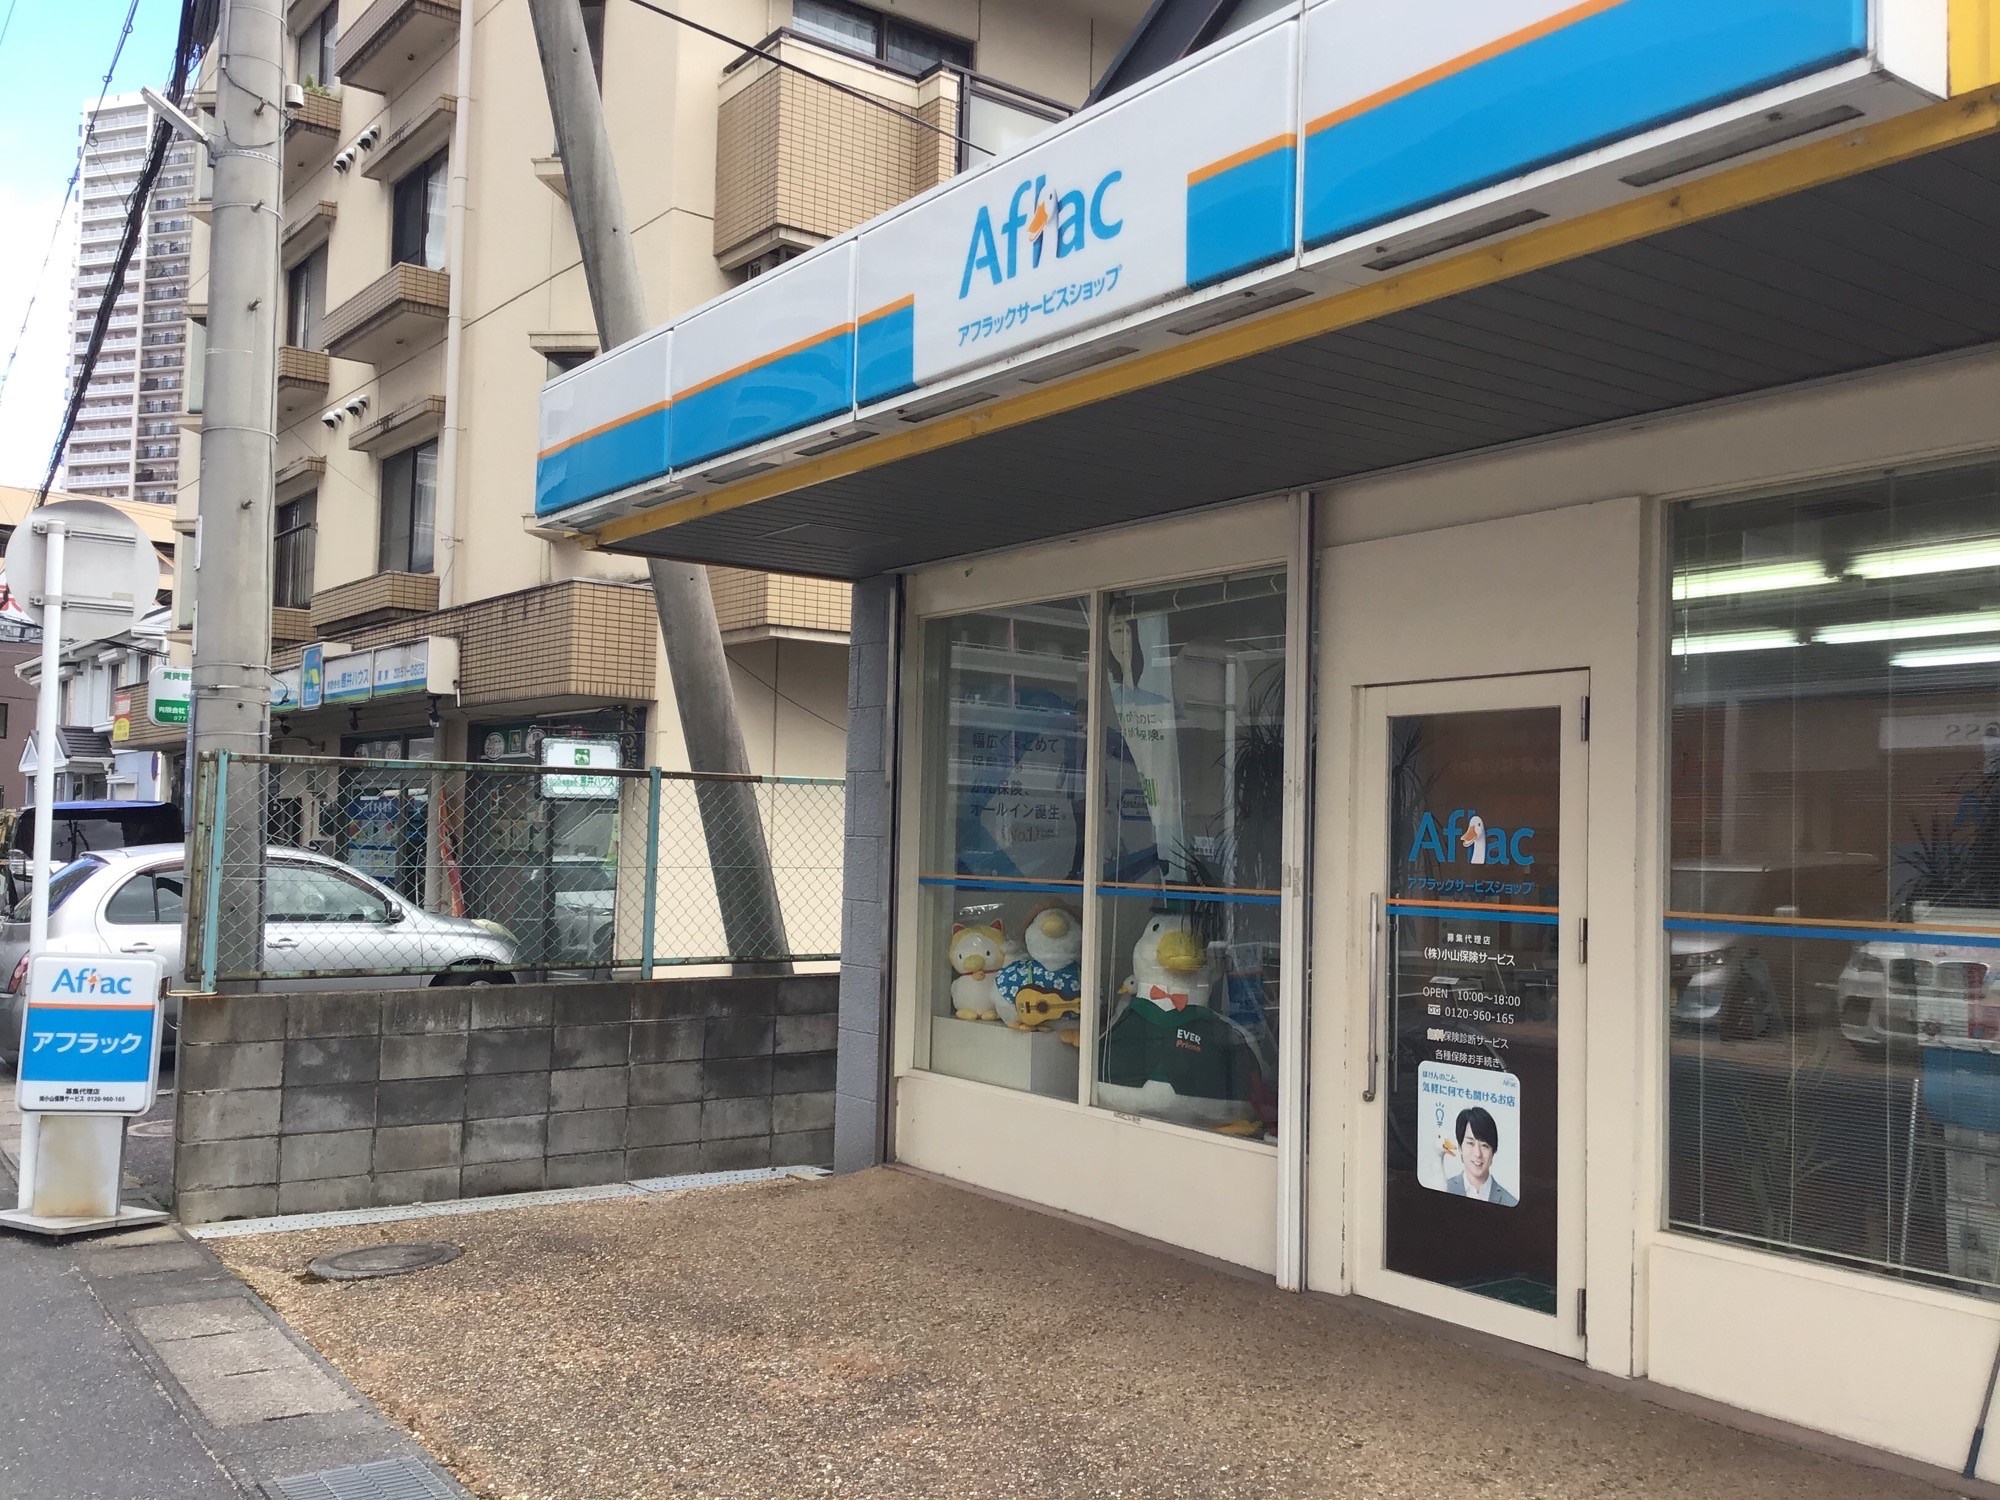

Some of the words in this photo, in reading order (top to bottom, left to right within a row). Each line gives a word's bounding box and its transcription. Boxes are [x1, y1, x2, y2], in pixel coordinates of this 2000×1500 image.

[959, 170, 1123, 299] Aflac
[958, 264, 1123, 347] アフラックサービスショップ
[972, 731, 1058, 754] 幅広くとめて
[1407, 877, 1534, 895] アフラックサービスショップ
[1446, 932, 1492, 946] 募集代理店
[51, 968, 132, 994] Aflac
[1422, 986, 1448, 999] OPEN
[1444, 1006, 1515, 1025] 0120-960-165
[32, 1032, 142, 1054] アフラック
[1176, 1028, 1201, 1045] EVER
[1427, 1028, 1509, 1050] 保険診断サービス
[1435, 1048, 1501, 1069] 各種保険お手続き
[65, 1087, 100, 1096] 募集代理店
